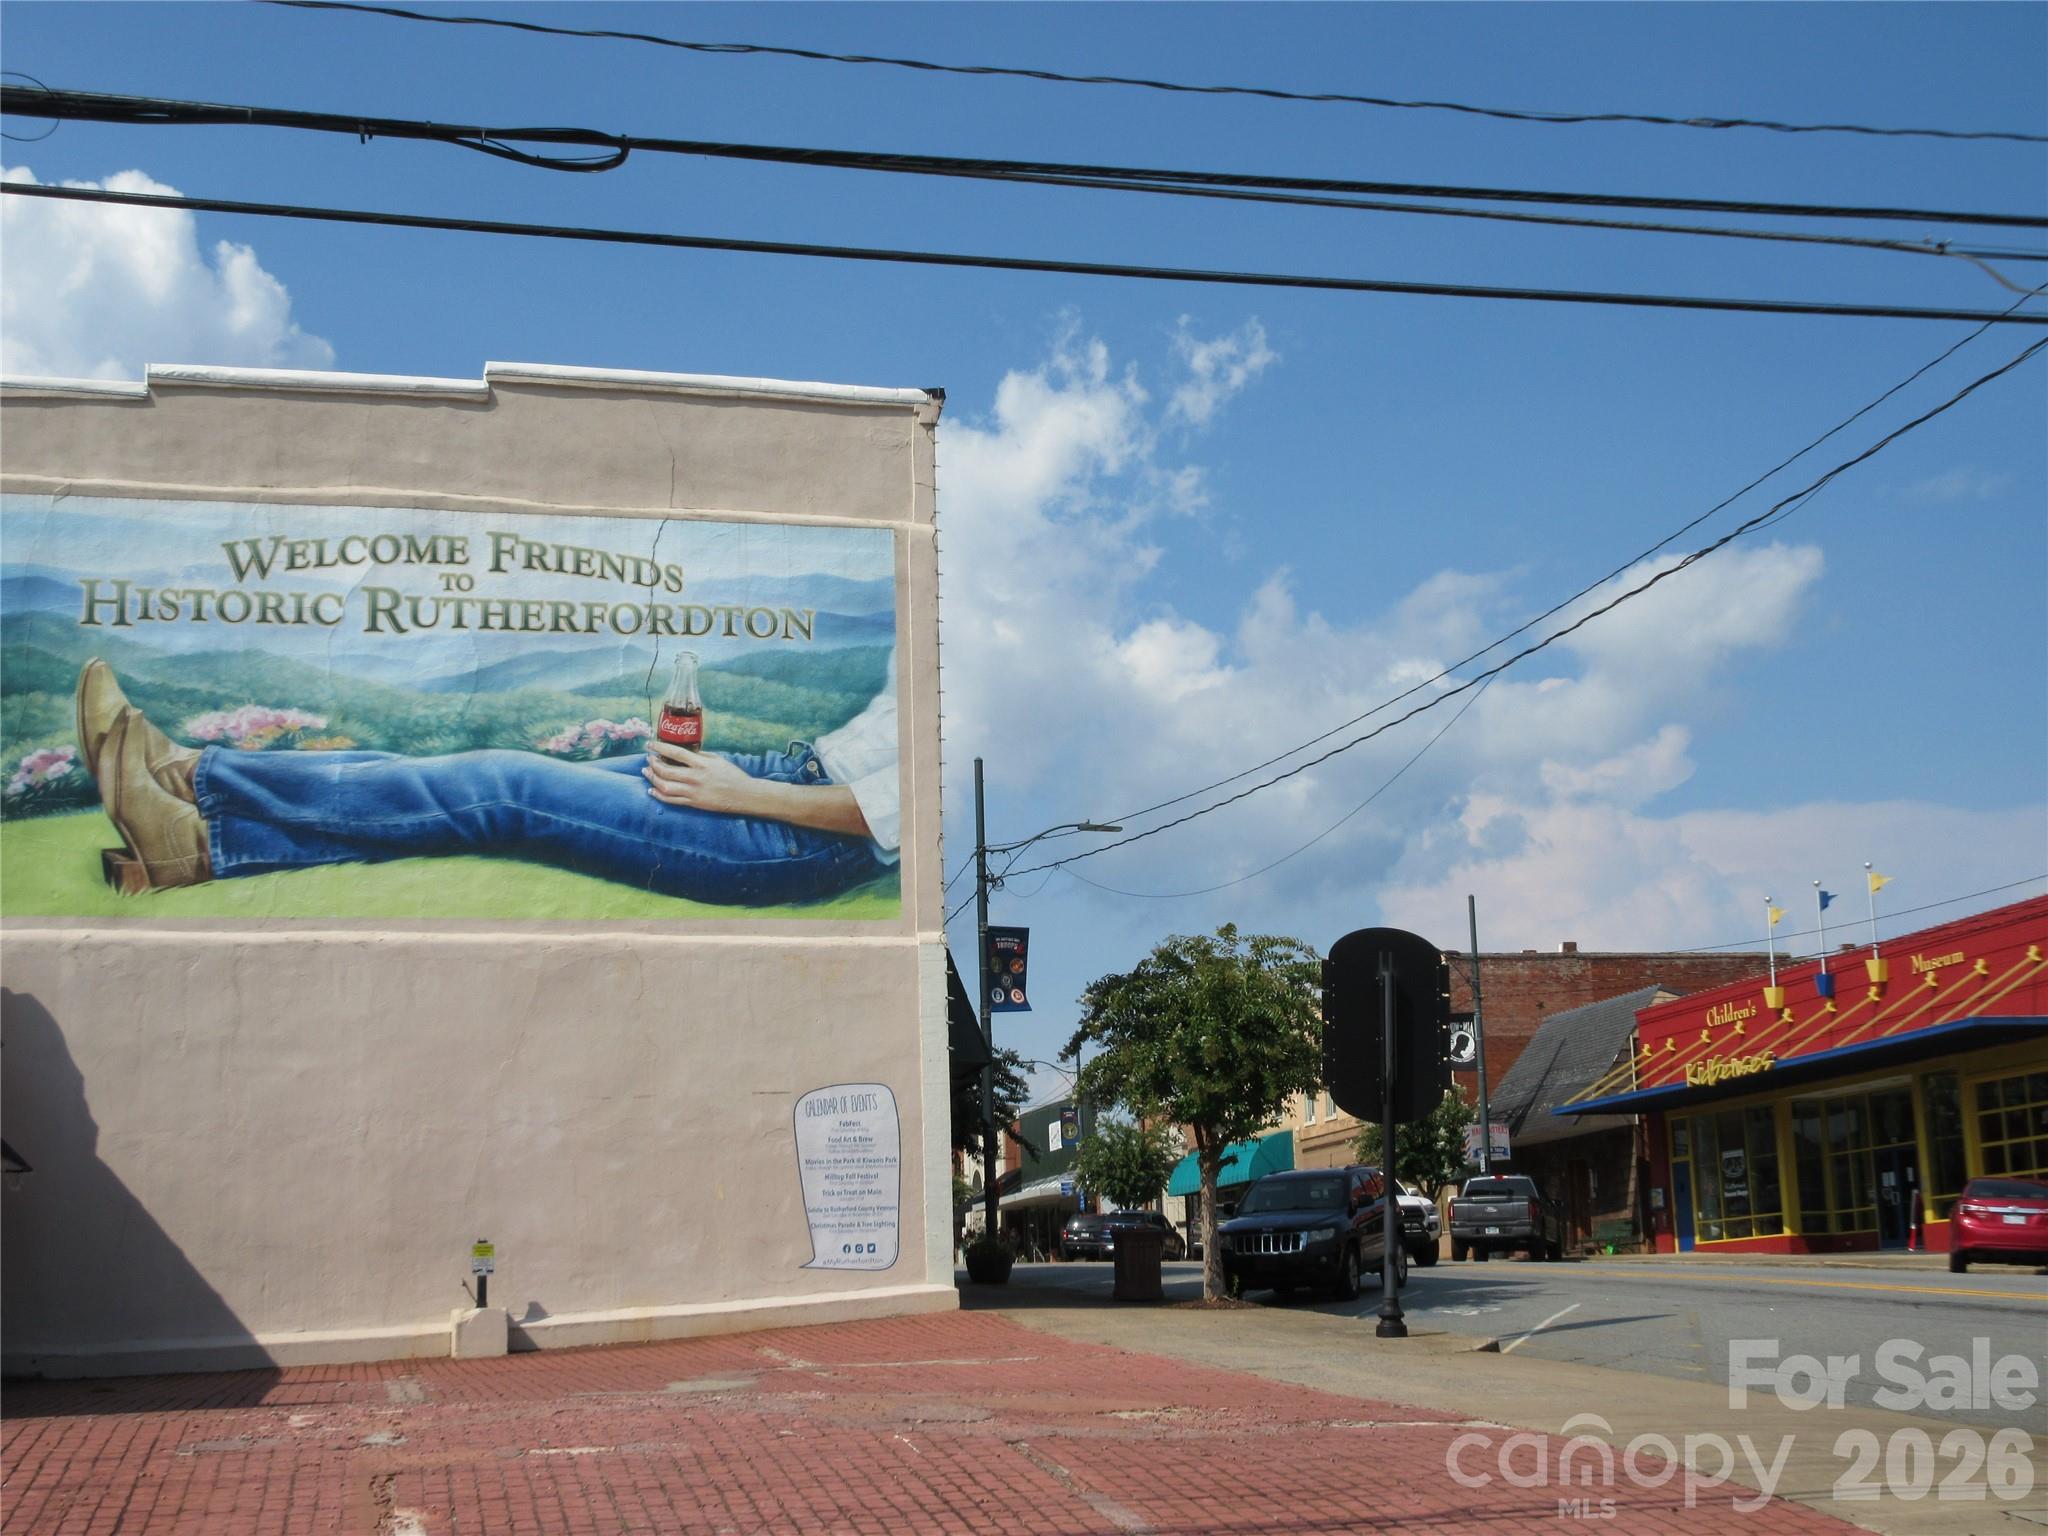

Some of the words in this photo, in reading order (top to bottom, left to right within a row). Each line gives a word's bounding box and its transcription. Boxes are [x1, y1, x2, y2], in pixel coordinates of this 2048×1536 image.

[222, 532, 469, 584] WELCOME
[487, 530, 685, 594] FRIENDS
[438, 571, 476, 592] TO
[79, 578, 344, 627] HISTORIC
[363, 586, 816, 641] RUTHERFORDTON
[1911, 950, 1966, 975] Museum
[1706, 1000, 1757, 1027] Children's
[1685, 1051, 1776, 1088] KidSenses
[805, 1097, 839, 1118] CALENDAR
[851, 1093, 878, 1113] EVENTS
[828, 1136, 842, 1144] Food
[842, 1135, 852, 1143] Art
[859, 1135, 873, 1143] Brew
[857, 1172, 879, 1180] Festival
[822, 1189, 835, 1197] Trick
[843, 1188, 858, 1196] Treat
[867, 1187, 882, 1196] Main
[811, 1222, 837, 1230] Christmas
[838, 1221, 856, 1229] Parade
[874, 1220, 896, 1230] Lighting
